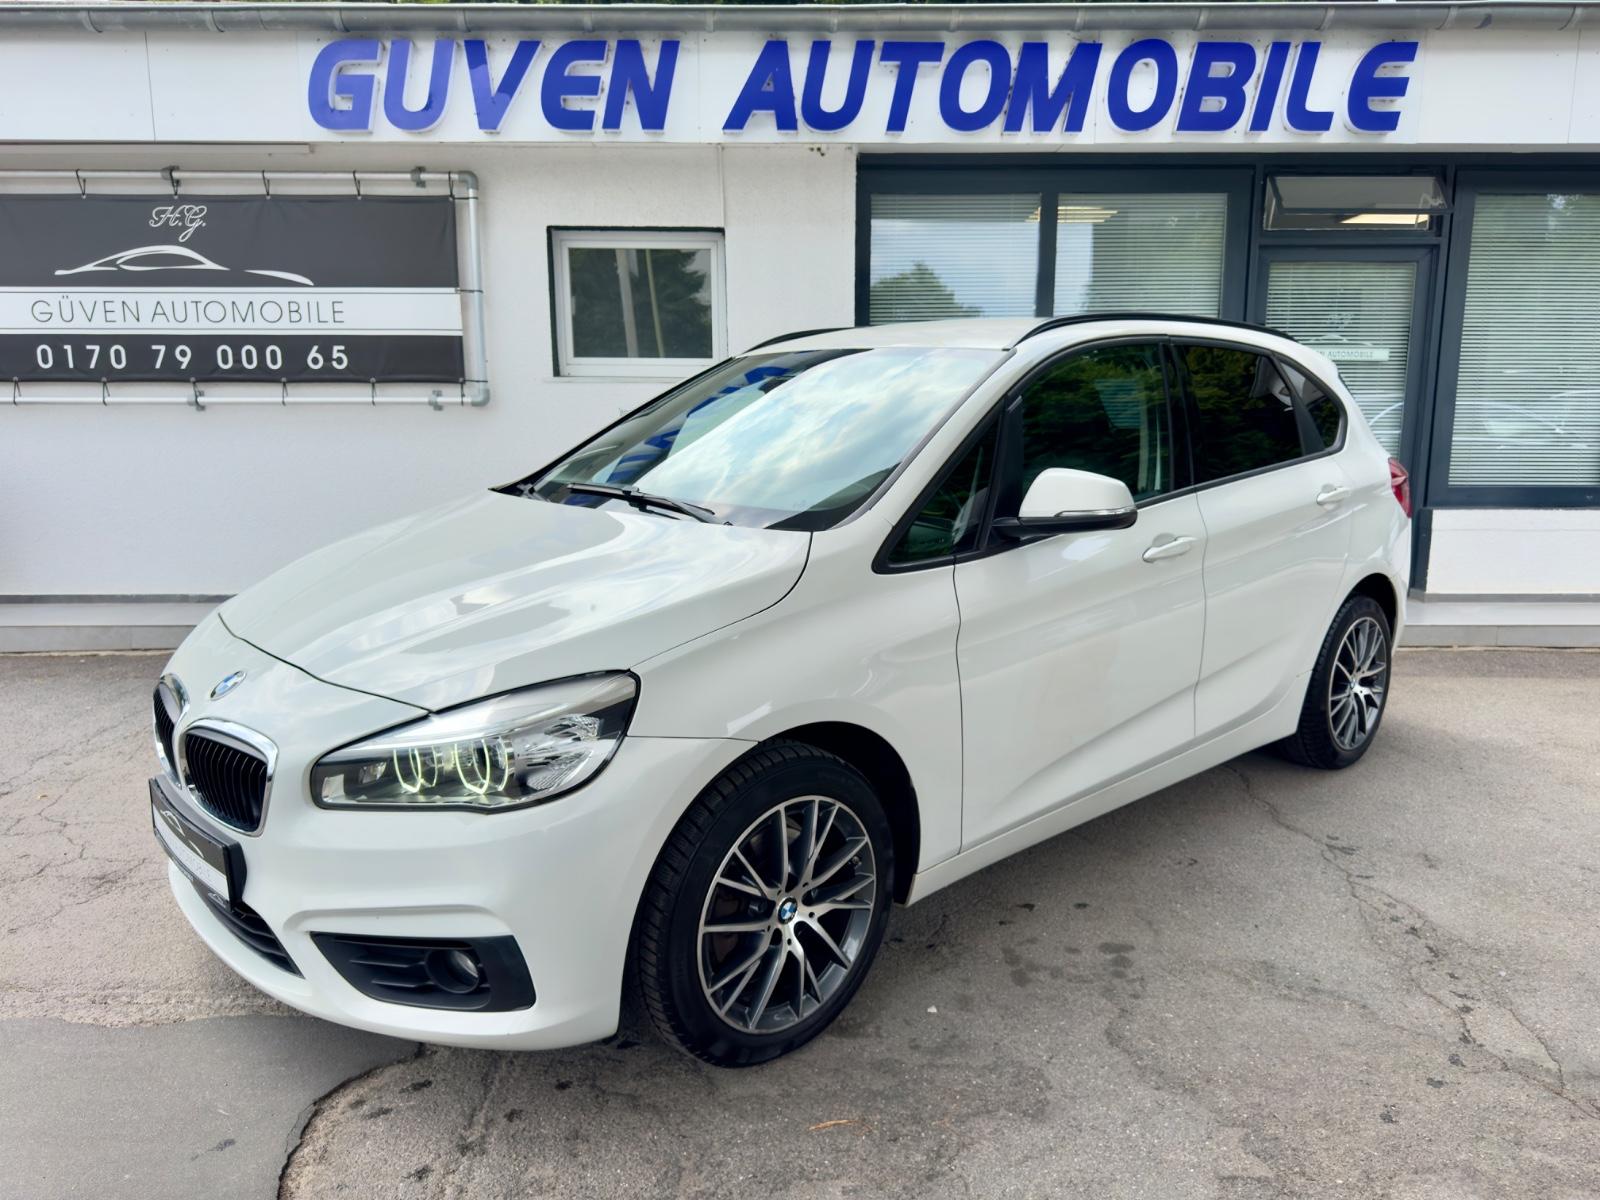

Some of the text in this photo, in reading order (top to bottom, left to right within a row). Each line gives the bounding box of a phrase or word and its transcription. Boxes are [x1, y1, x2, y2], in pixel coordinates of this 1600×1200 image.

[307, 38, 1419, 133] GUVEN AUTOMOBILE
[149, 204, 208, 243] H.G.
[31, 295, 345, 324] GÜVEN AUTOMOBILE
[36, 344, 348, 370] 0170 79 000 65
